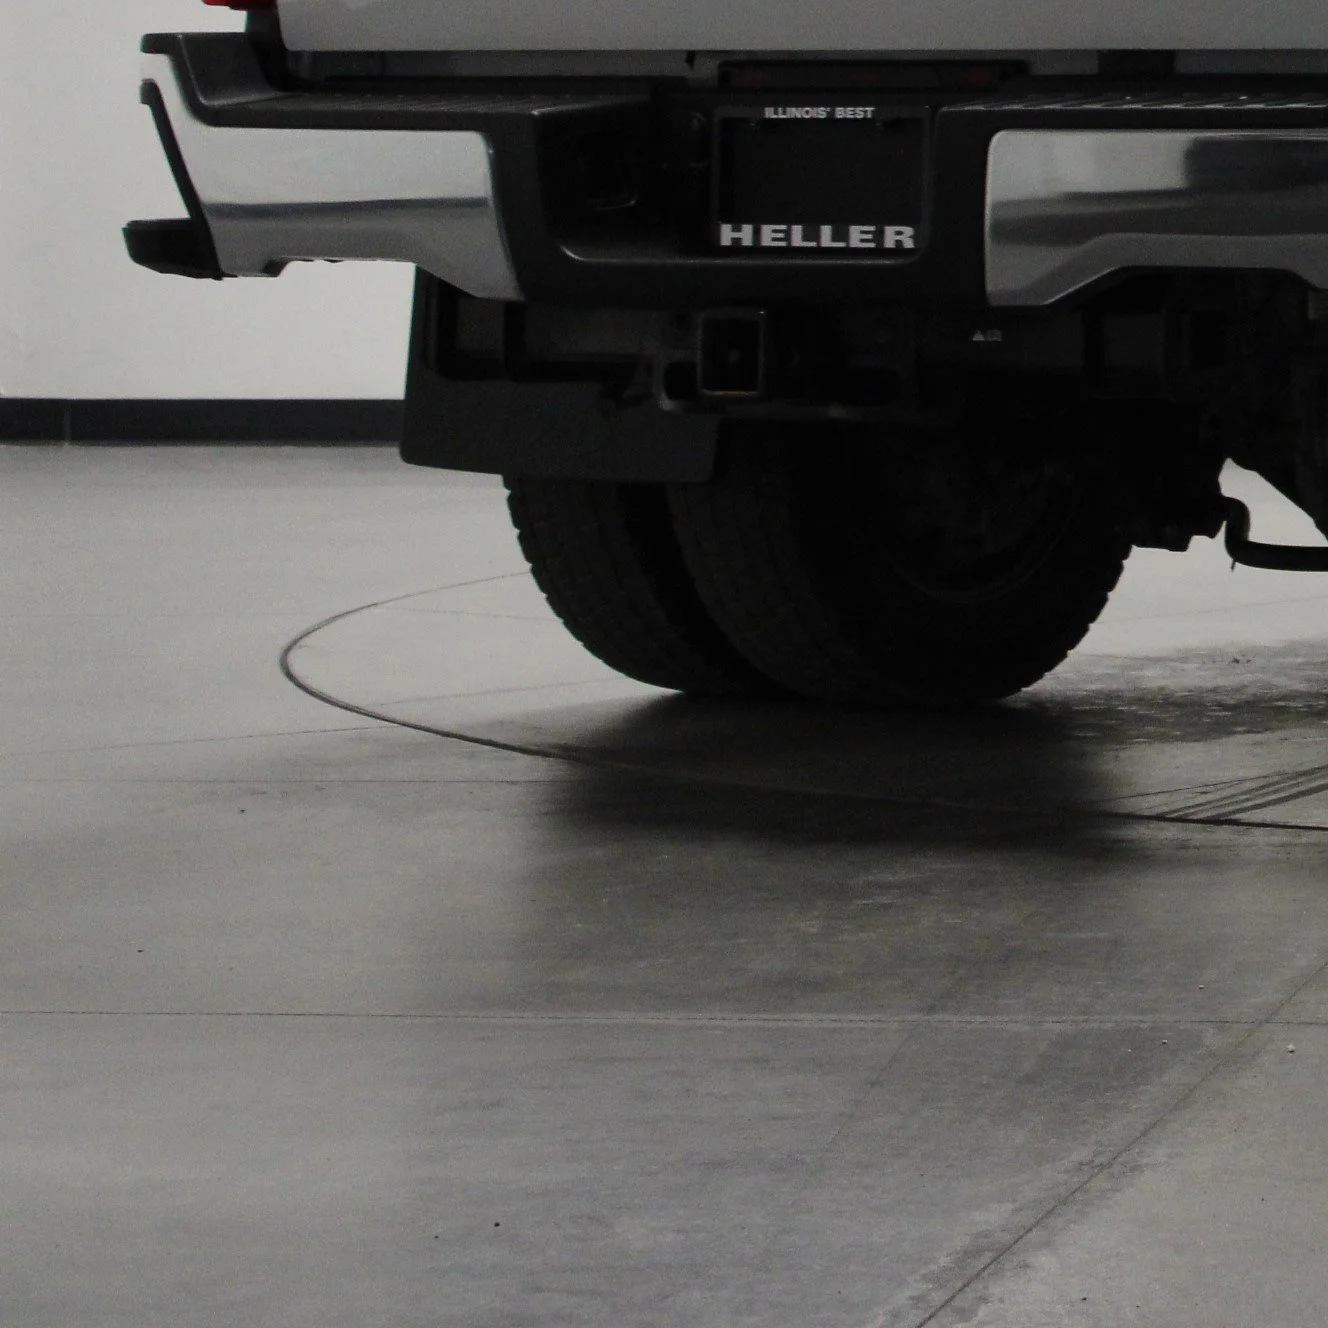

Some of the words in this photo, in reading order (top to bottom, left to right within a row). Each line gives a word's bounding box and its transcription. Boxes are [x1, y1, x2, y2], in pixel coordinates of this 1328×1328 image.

[764, 107, 831, 119] ILLINOIS'
[834, 107, 876, 119] BEST
[719, 223, 916, 249] HELLER
